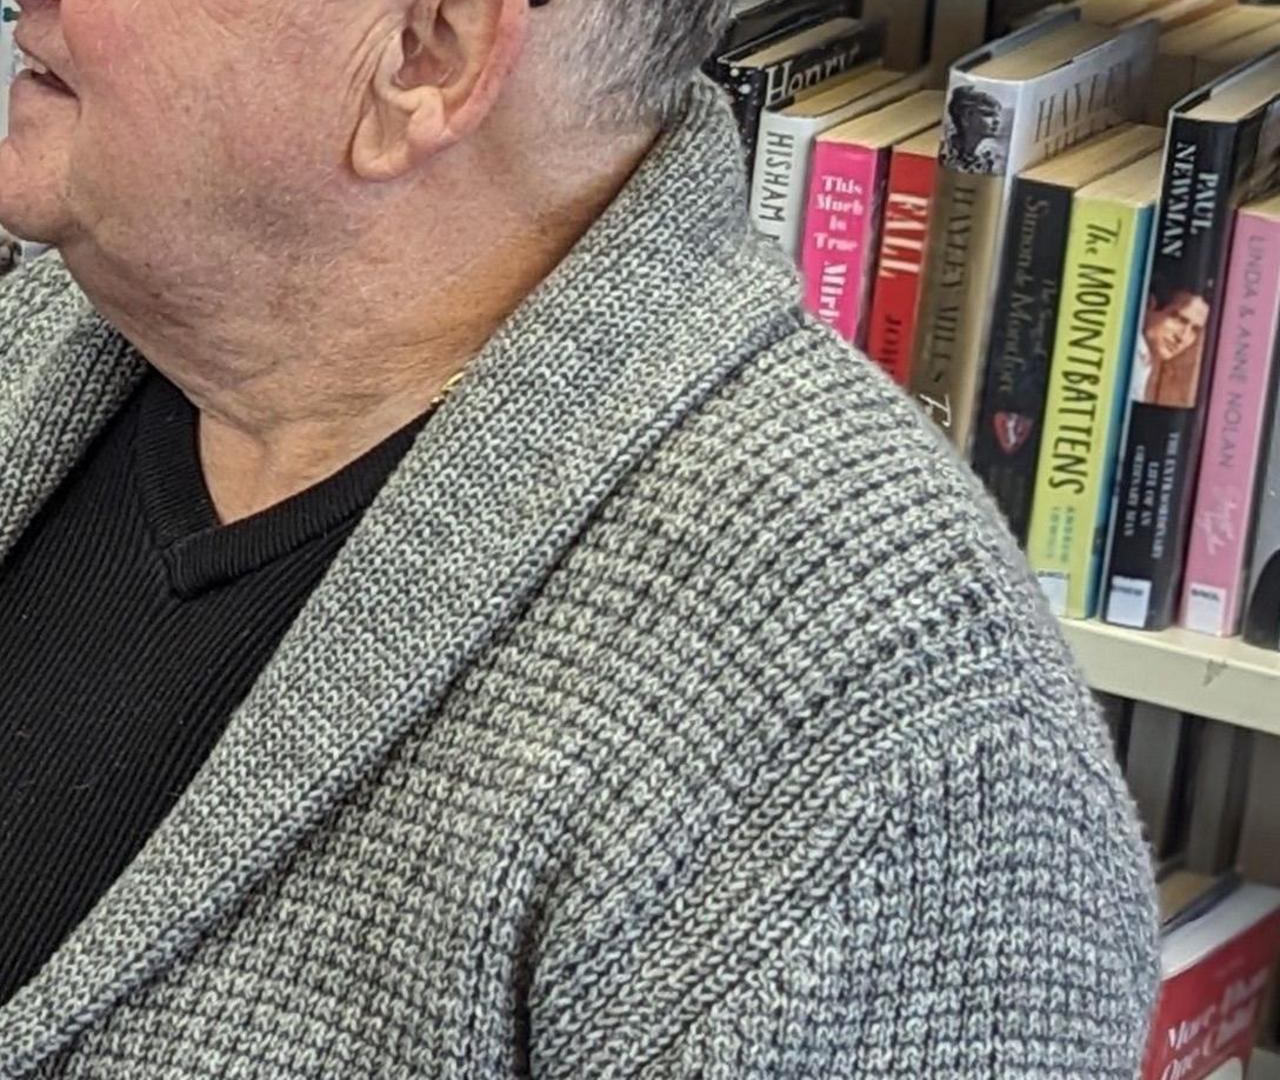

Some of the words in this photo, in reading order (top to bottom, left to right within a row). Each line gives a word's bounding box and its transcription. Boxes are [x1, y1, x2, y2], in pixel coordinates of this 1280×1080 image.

[758, 130, 794, 223] HISHAM
[816, 194, 864, 216] Much
[821, 175, 863, 194] This
[1158, 140, 1199, 259] NEWMAN
[1190, 171, 1220, 242] PAUL
[812, 232, 859, 252] True
[940, 185, 977, 289] HAYLEY
[1016, 195, 1050, 269] Simon
[1085, 218, 1122, 256] The
[1241, 233, 1266, 298] LINDA
[931, 304, 961, 384] MILLS
[997, 292, 1037, 395] Montfort
[1048, 262, 1118, 496] MOUNTBATTENS
[1229, 332, 1251, 383] ANNE
[1218, 389, 1243, 470] NOLAN
[1147, 459, 1161, 486] LIFE
